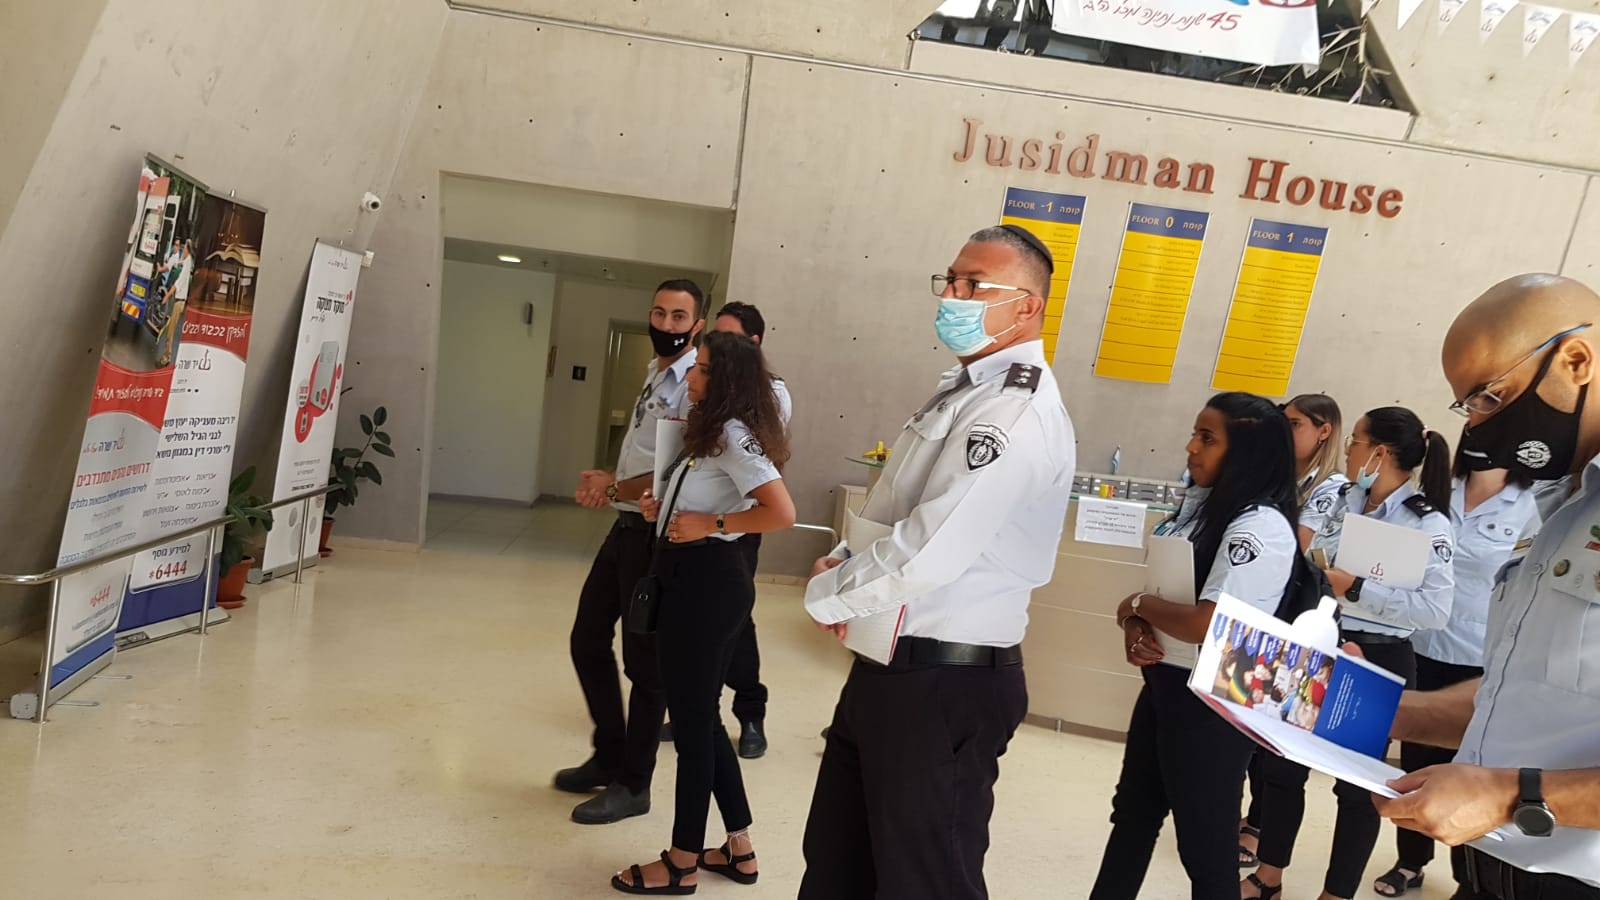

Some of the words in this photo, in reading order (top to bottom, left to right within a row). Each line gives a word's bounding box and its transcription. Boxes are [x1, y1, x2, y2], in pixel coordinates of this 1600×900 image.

[1137, 8, 1174, 28] נתינה
[1172, 12, 1206, 31] שנות
[1206, 12, 1242, 31] 45
[953, 116, 1214, 194] Jusidman
[1239, 157, 1404, 218] House
[1008, 199, 1036, 210] FLOOR
[1040, 201, 1053, 213] -1
[1059, 206, 1081, 216] קומה
[1131, 214, 1160, 225] FLOOR
[1165, 216, 1174, 228] 0
[1183, 222, 1204, 232] קומה
[1252, 230, 1281, 241] FLOOR
[1287, 231, 1295, 243] 1
[1302, 237, 1323, 247] קומה
[201, 324, 226, 337] בכבוד
[188, 416, 216, 429] מעניקה
[165, 431, 189, 443] השלישי
[190, 430, 207, 441] הגיל
[208, 429, 222, 441] לבני
[194, 446, 205, 458] דין
[76, 469, 111, 488] מתנדבים
[152, 548, 168, 561] נוסף
[169, 544, 192, 556] למידע
